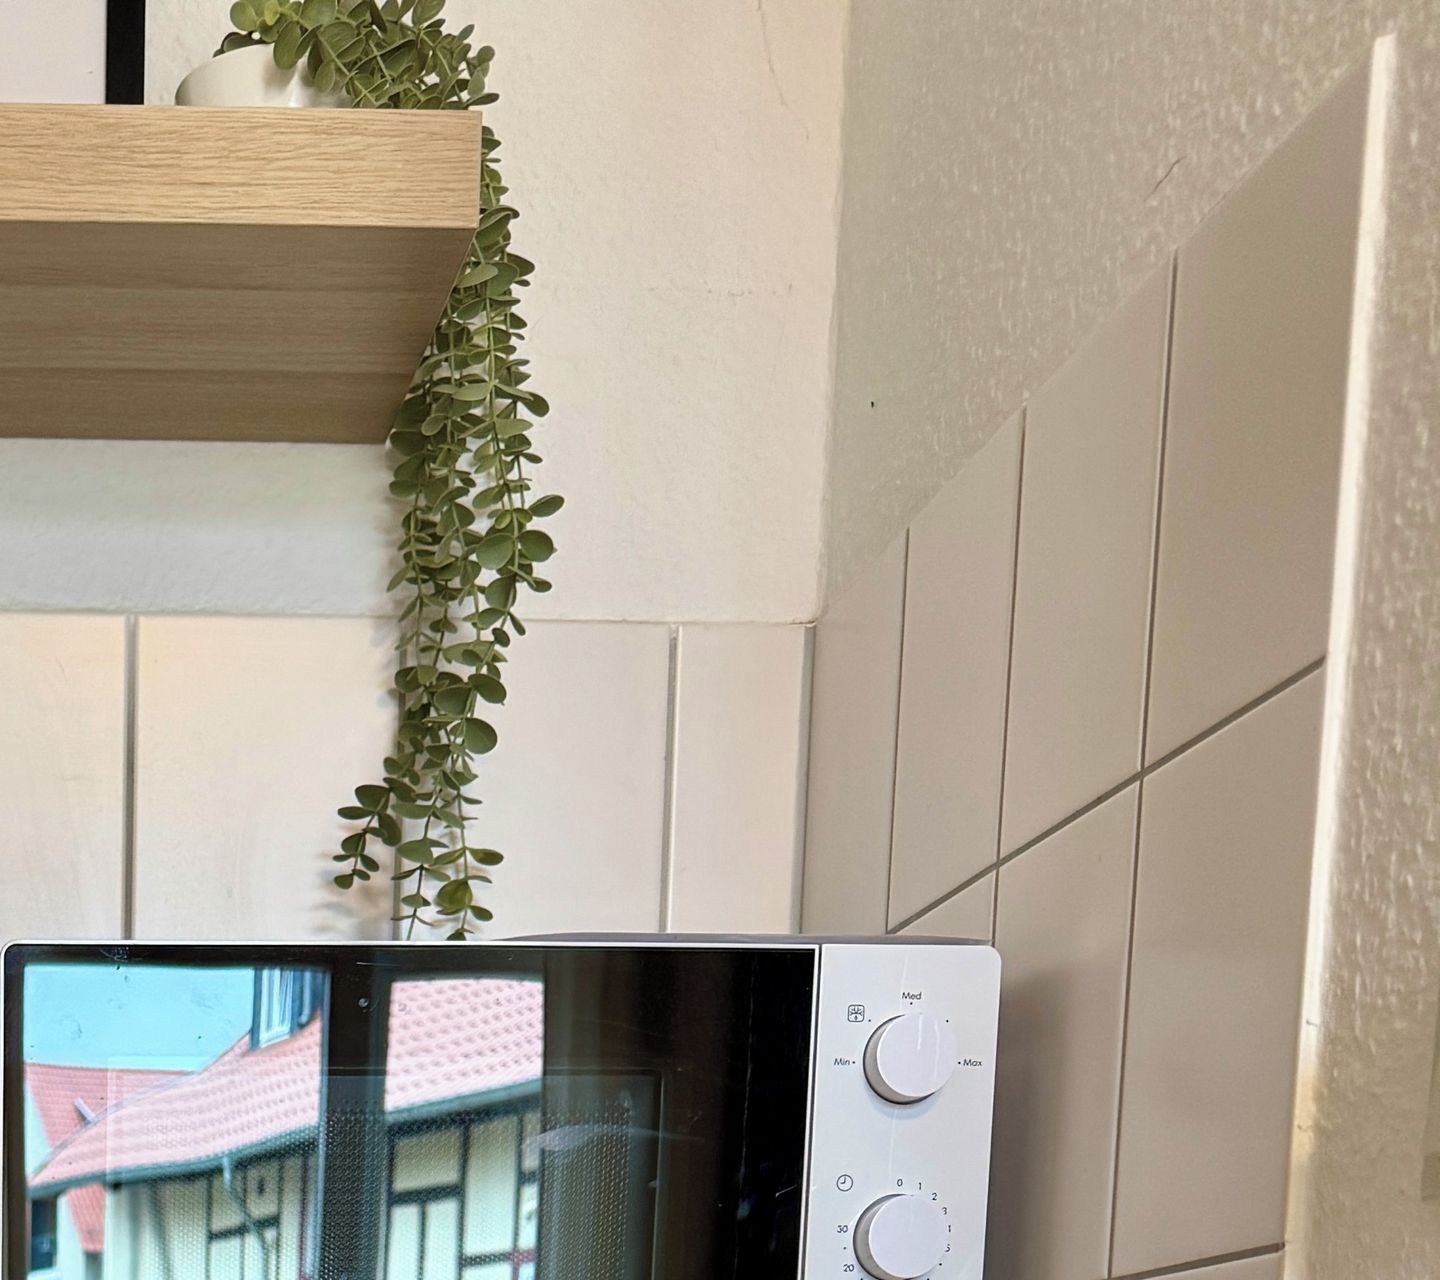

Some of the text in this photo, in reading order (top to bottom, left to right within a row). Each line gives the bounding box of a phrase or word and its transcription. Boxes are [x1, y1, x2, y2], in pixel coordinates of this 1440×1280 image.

[901, 991, 923, 1000] Med
[833, 1058, 851, 1066] Min
[963, 1058, 983, 1067] Max
[896, 1178, 904, 1187] 0
[917, 1182, 922, 1191] 1
[931, 1192, 938, 1201] 2
[836, 1224, 849, 1233] 30
[843, 1263, 855, 1272] 20
